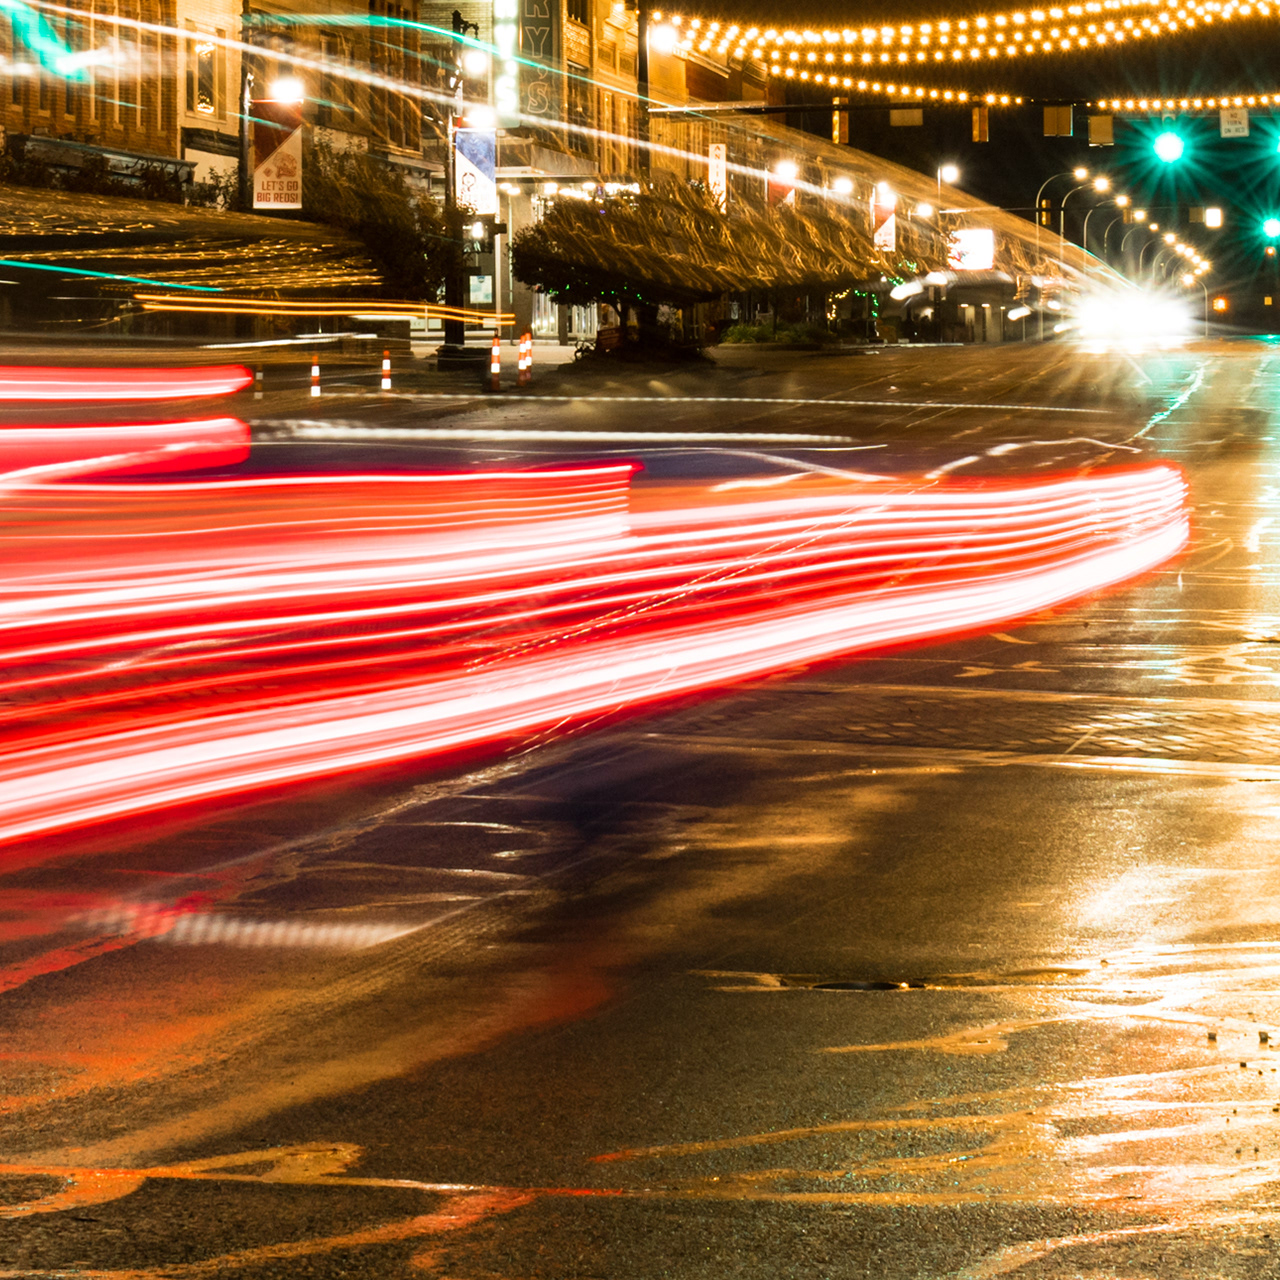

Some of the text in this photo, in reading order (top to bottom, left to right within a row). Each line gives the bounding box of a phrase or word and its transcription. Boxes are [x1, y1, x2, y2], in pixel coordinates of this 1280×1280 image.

[261, 181, 298, 191] LET'S GO
[257, 192, 298, 203] BIG REDS!
